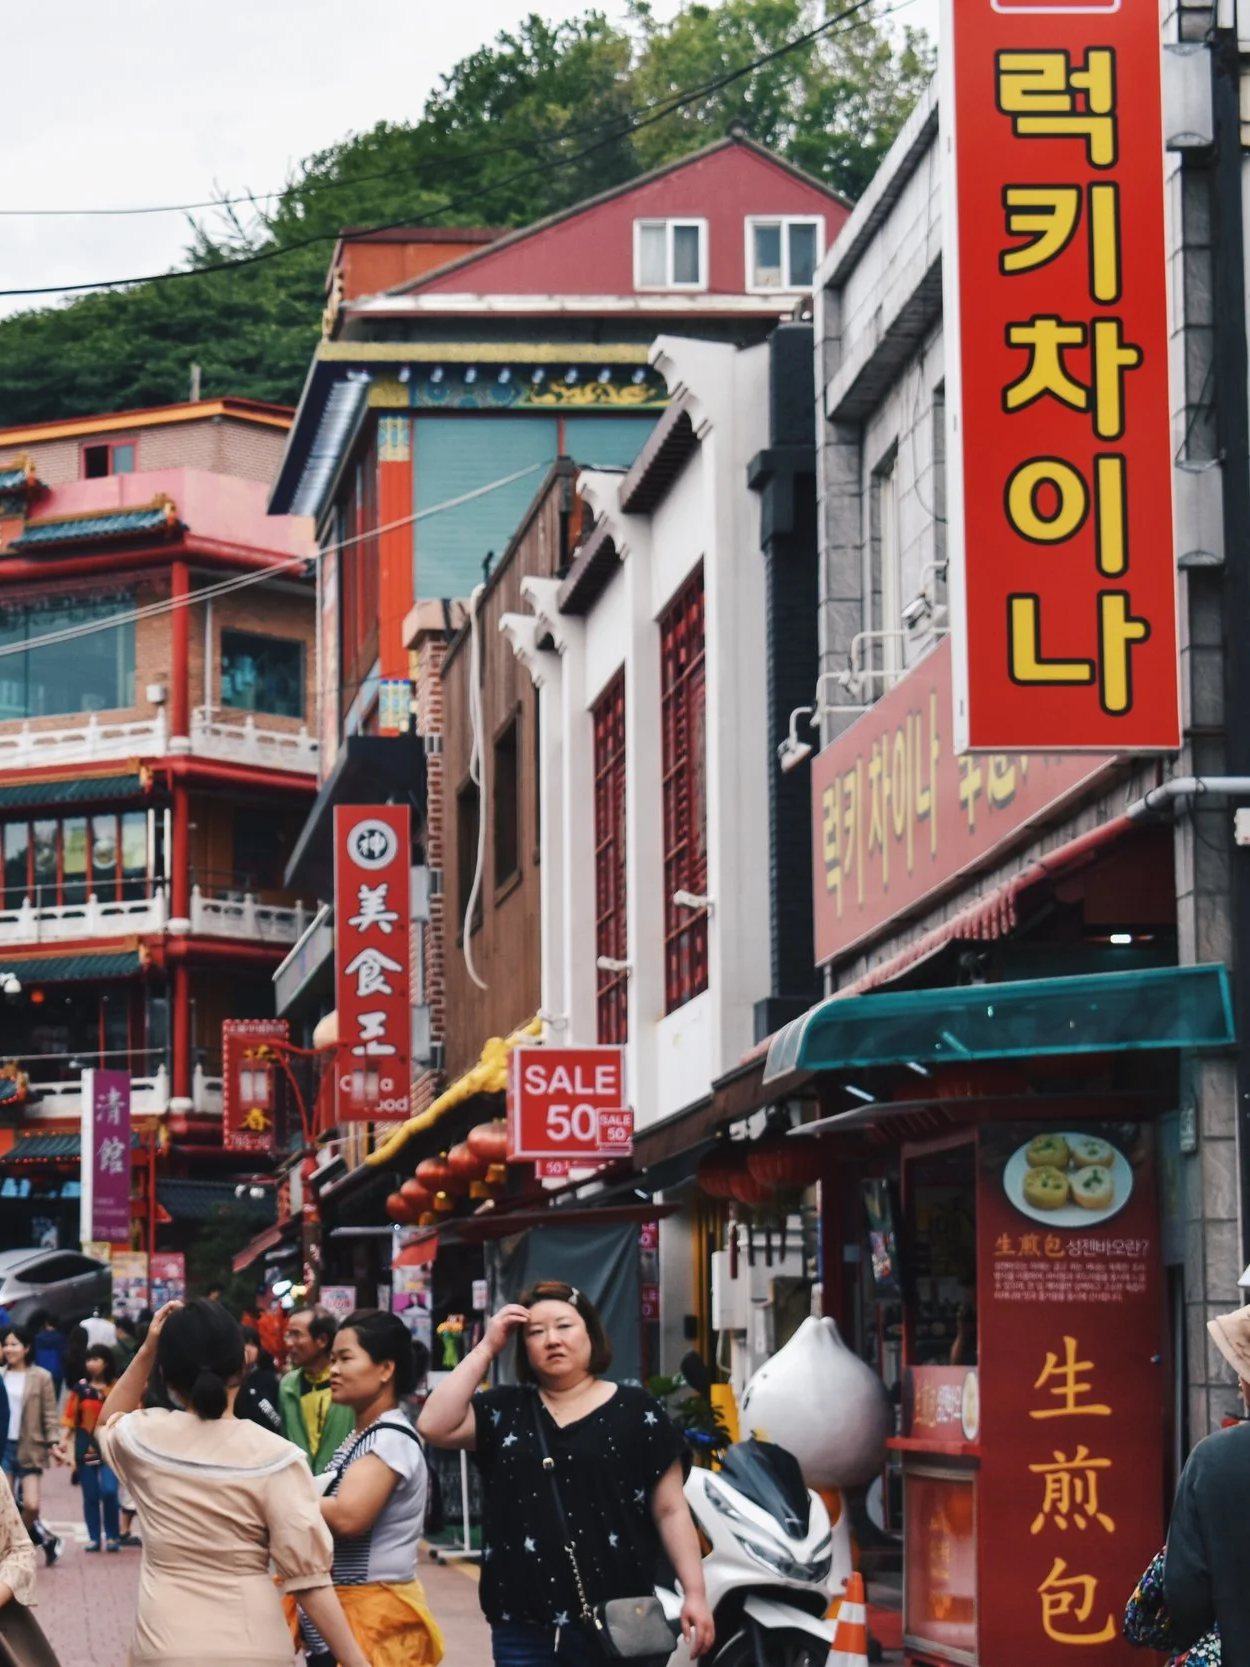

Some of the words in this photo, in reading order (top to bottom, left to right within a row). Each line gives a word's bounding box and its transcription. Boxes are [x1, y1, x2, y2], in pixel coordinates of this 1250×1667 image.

[995, 46, 1150, 715] 럭키차이나
[822, 686, 940, 922] 럭키차이나
[524, 1064, 617, 1096] SALE
[545, 1102, 597, 1142] 50
[599, 1113, 631, 1126] SALE
[993, 1231, 1066, 1258] 生煎包
[1028, 1335, 1116, 1645] 生煎包
